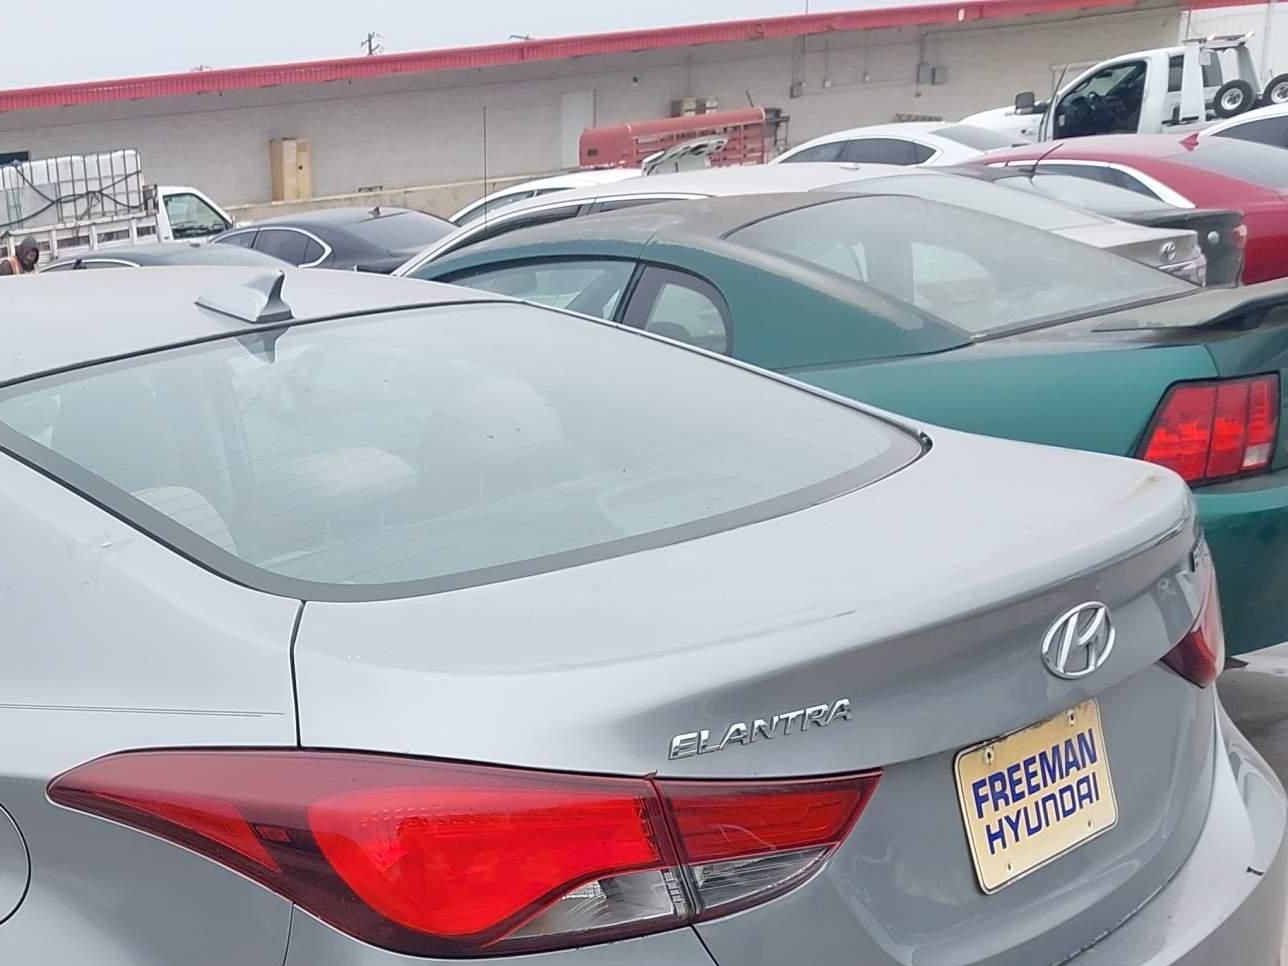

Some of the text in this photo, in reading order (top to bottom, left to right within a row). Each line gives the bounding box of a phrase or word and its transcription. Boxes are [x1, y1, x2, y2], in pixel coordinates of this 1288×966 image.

[668, 698, 853, 761] ELANTRA
[971, 728, 1098, 819] FREEMAN
[985, 771, 1100, 855] HYUNDAI
